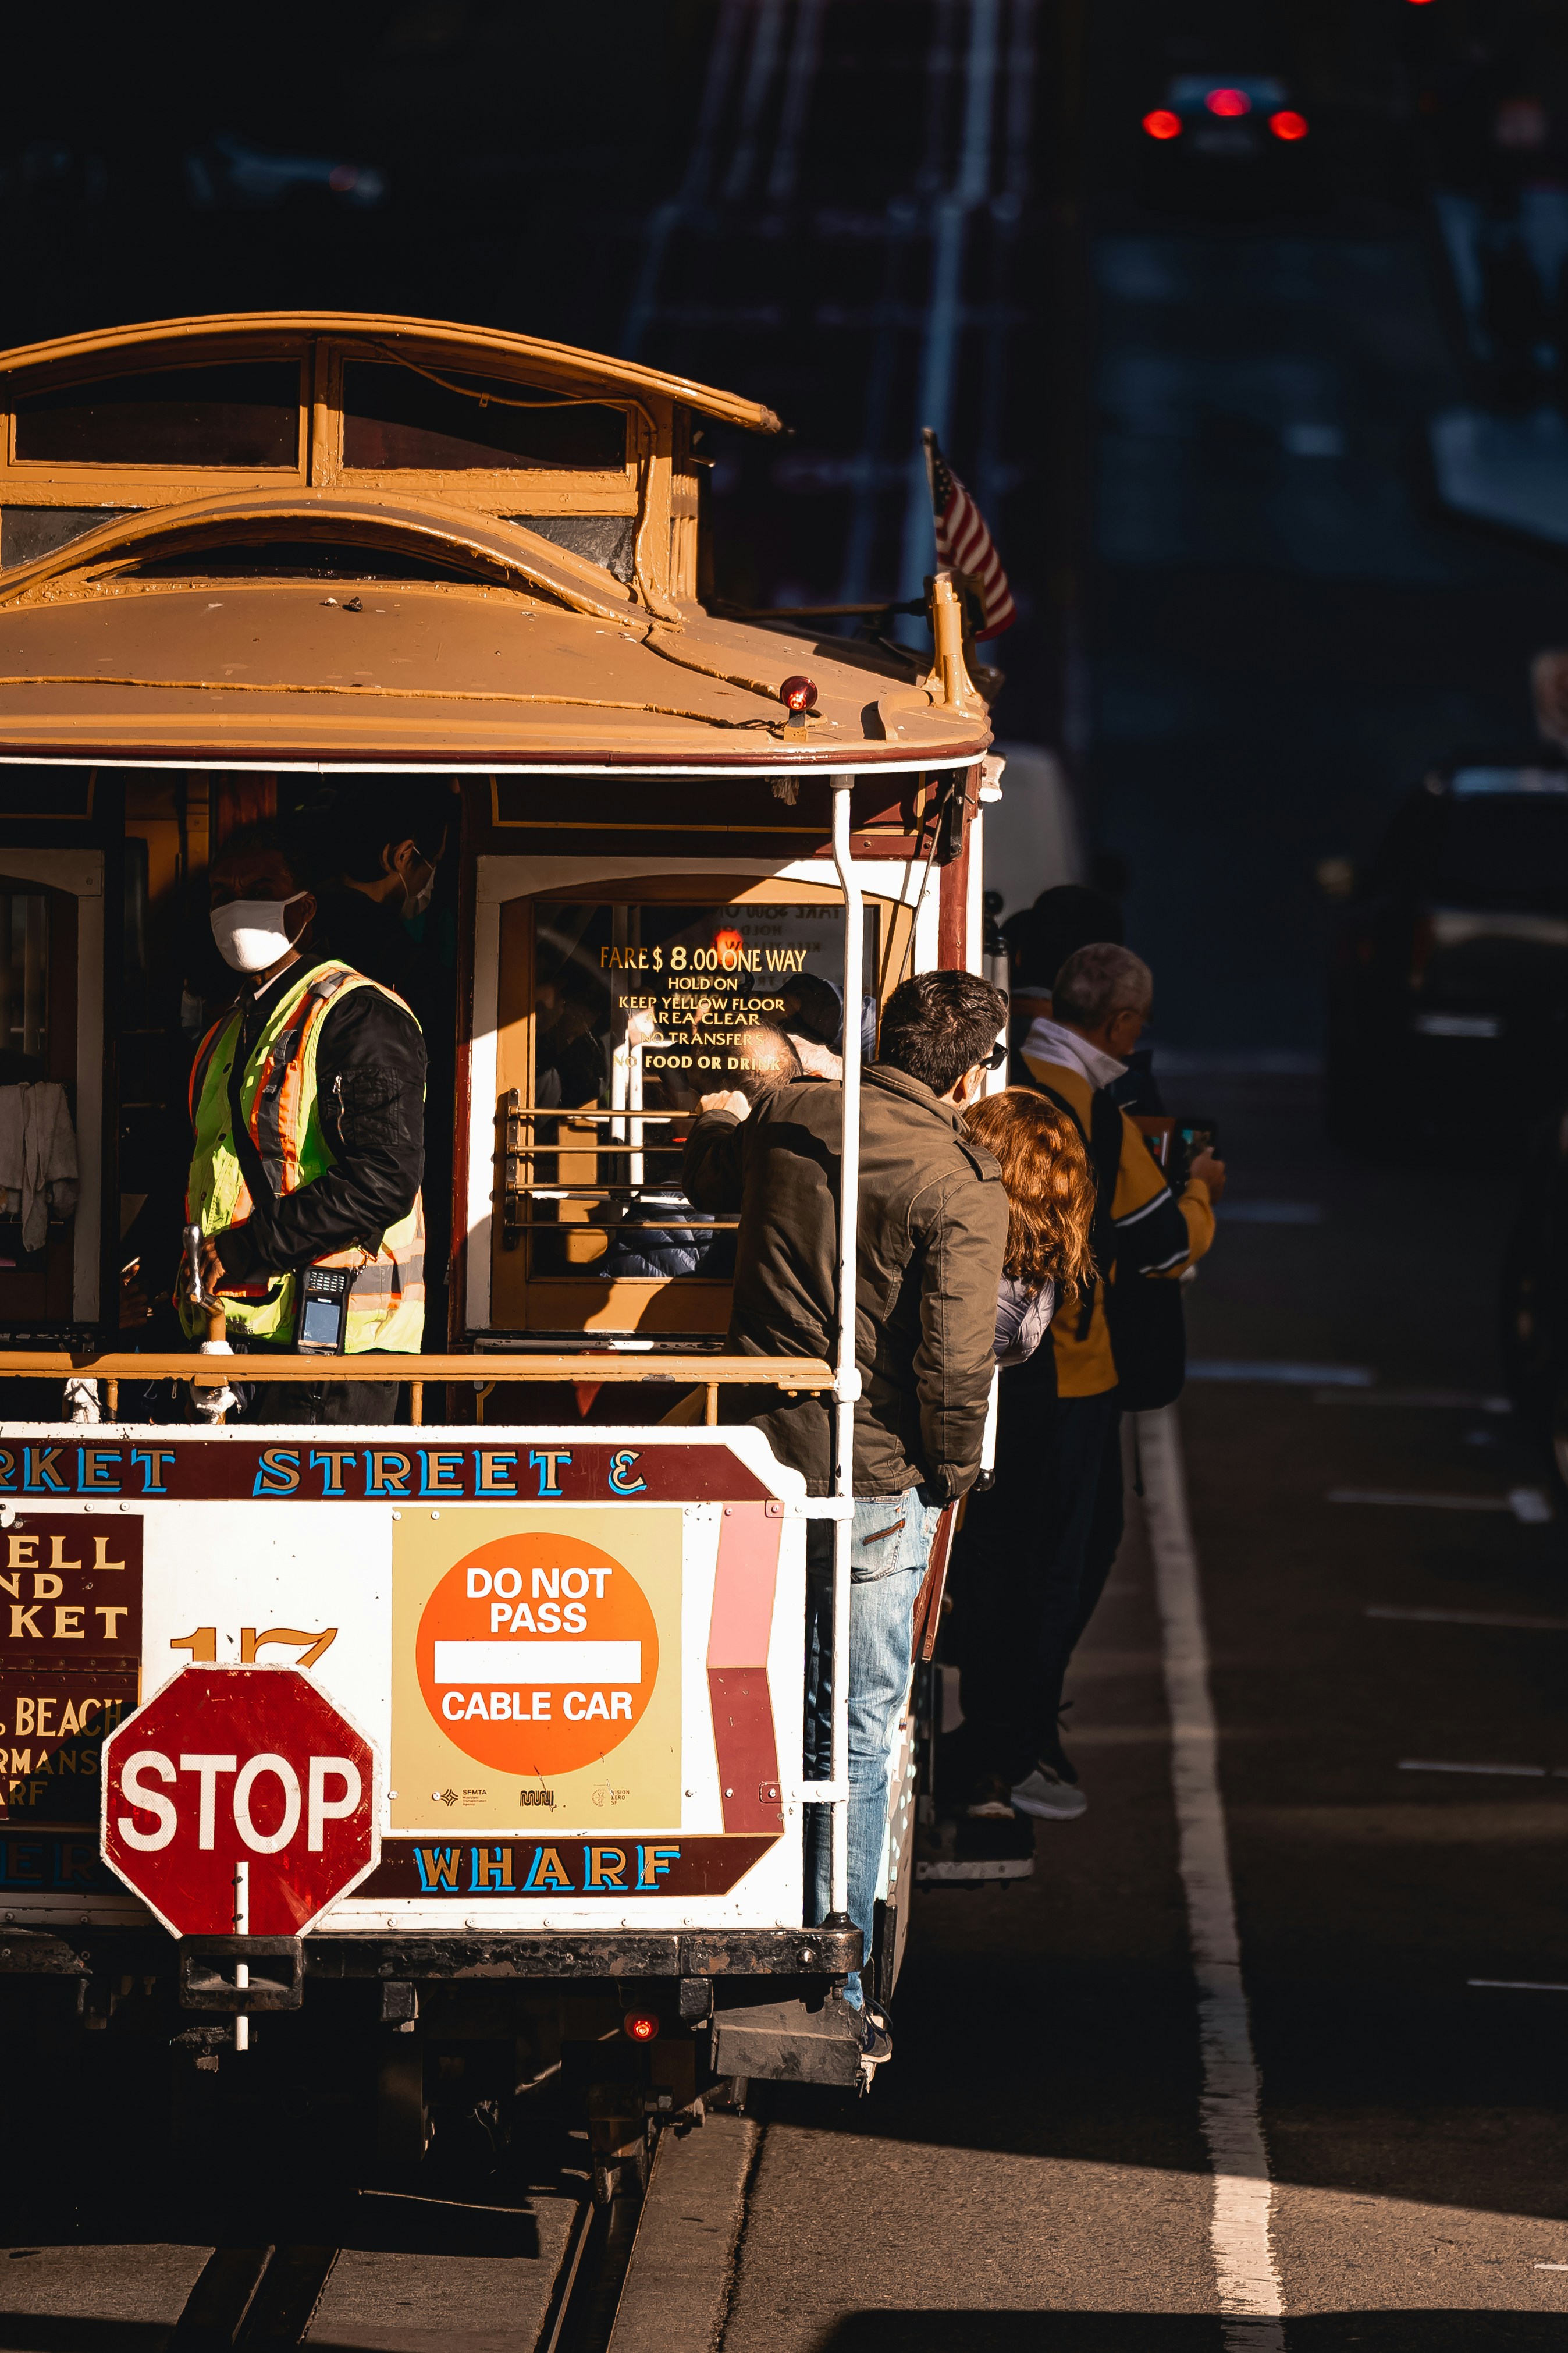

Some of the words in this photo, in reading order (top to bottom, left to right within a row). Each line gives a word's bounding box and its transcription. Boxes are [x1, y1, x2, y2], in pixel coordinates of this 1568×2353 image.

[600, 946, 649, 970] FARE
[722, 949, 762, 972] ONE
[765, 950, 807, 972] WAY
[669, 977, 710, 990] HOLD
[714, 978, 738, 991] ON
[618, 996, 657, 1009] KEEP
[662, 997, 728, 1010] YELLOW
[733, 998, 785, 1012] FLOOR
[645, 1012, 696, 1025] AREA
[702, 1013, 761, 1025] CLEAR
[641, 1032, 664, 1044] NO
[669, 1032, 765, 1046] TRANSFERS
[645, 1056, 692, 1069] FOOD
[697, 1056, 721, 1070] OR
[728, 1057, 781, 1071] DRINK
[253, 1447, 573, 1496] STREET
[467, 1567, 522, 1599] DO
[532, 1567, 613, 1599] NOT
[490, 1602, 588, 1634] PASS
[15, 1697, 123, 1737] BEACH
[442, 1691, 552, 1721] CABLE
[563, 1691, 633, 1720] CAR
[117, 1750, 362, 1854] STOP
[413, 1844, 681, 1891] WHARF
